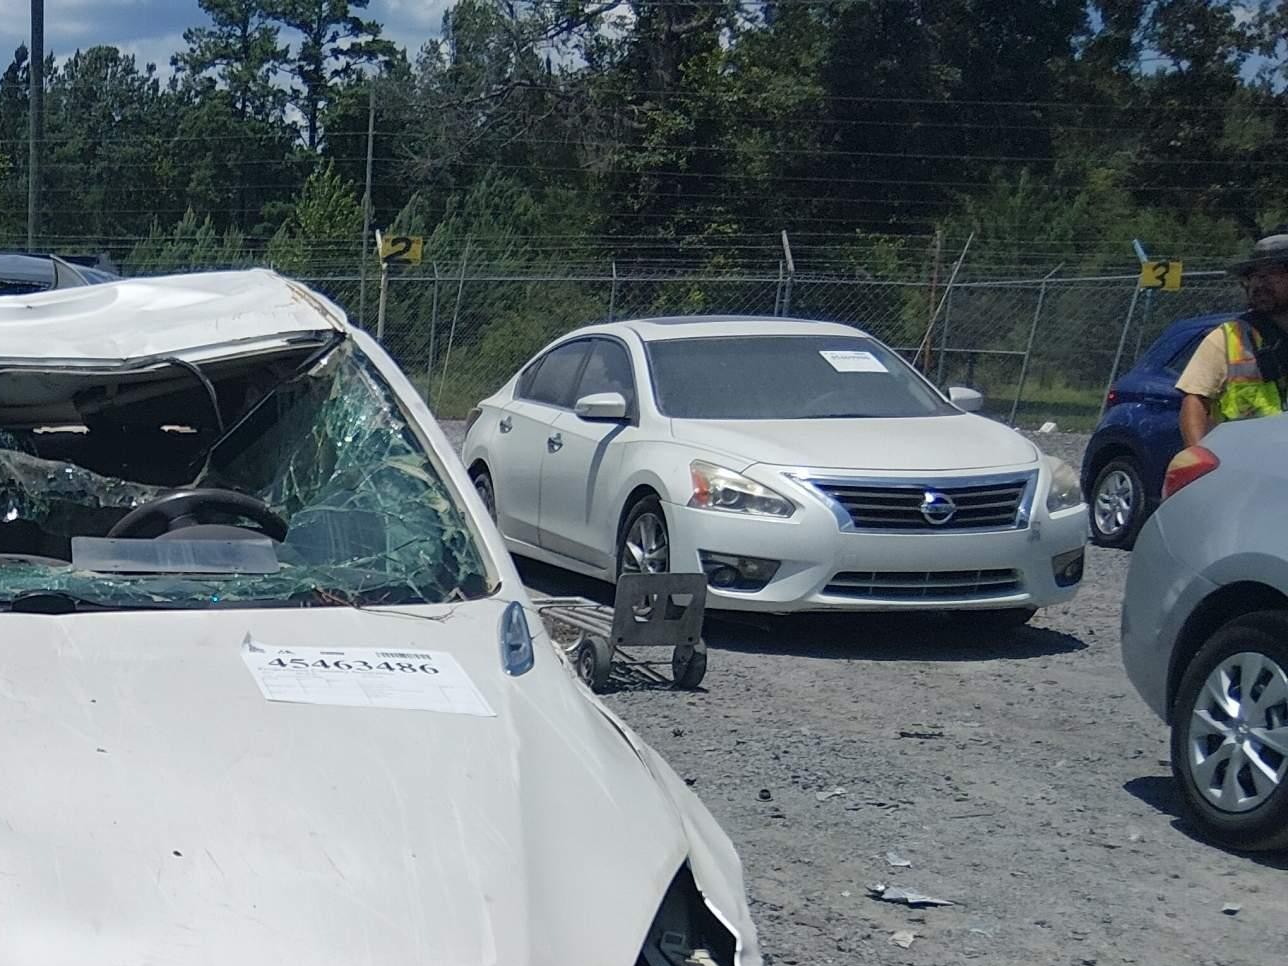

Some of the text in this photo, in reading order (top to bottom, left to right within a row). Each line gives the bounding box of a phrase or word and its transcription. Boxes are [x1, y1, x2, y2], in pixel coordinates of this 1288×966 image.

[382, 237, 412, 264] 2
[1151, 261, 1169, 289] 3
[268, 657, 439, 675] 45463486
